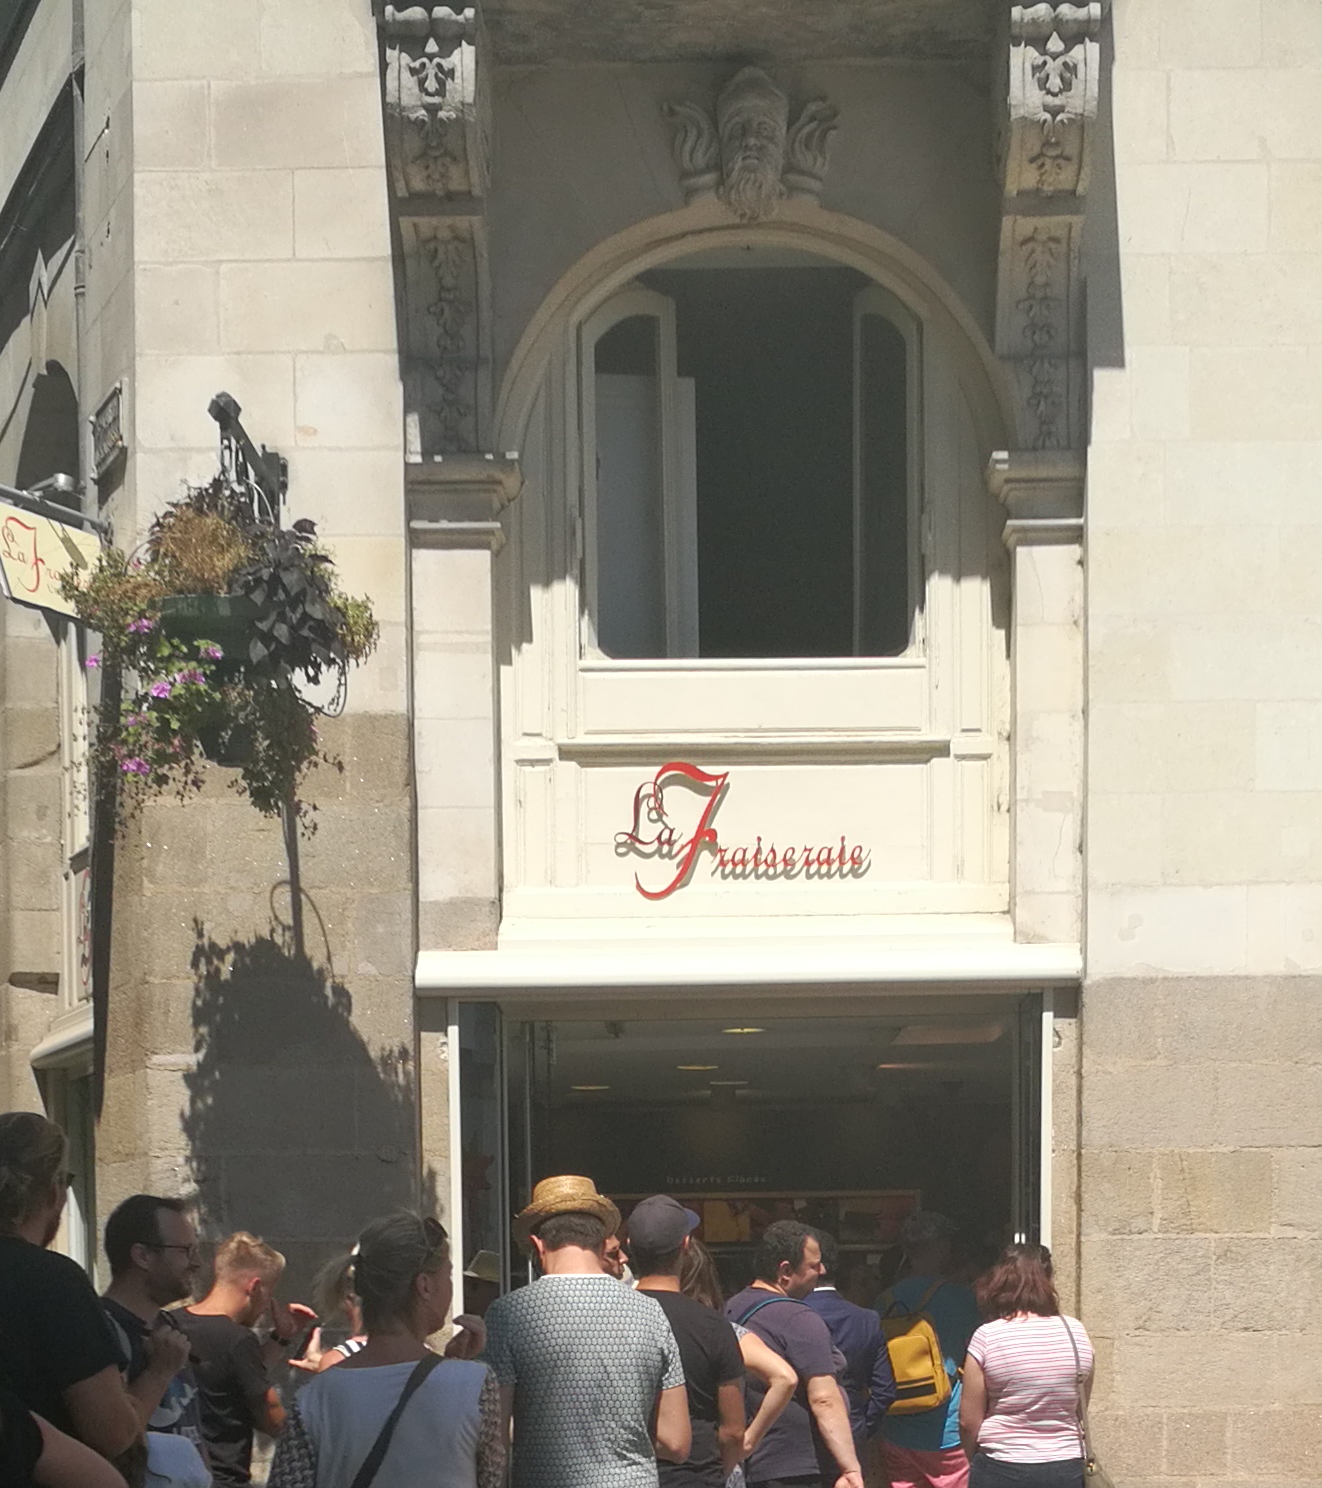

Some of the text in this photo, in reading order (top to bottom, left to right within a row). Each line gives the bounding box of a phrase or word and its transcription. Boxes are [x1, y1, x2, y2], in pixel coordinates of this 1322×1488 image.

[2, 526, 26, 565] La
[614, 761, 871, 901] La Fraiseraie
